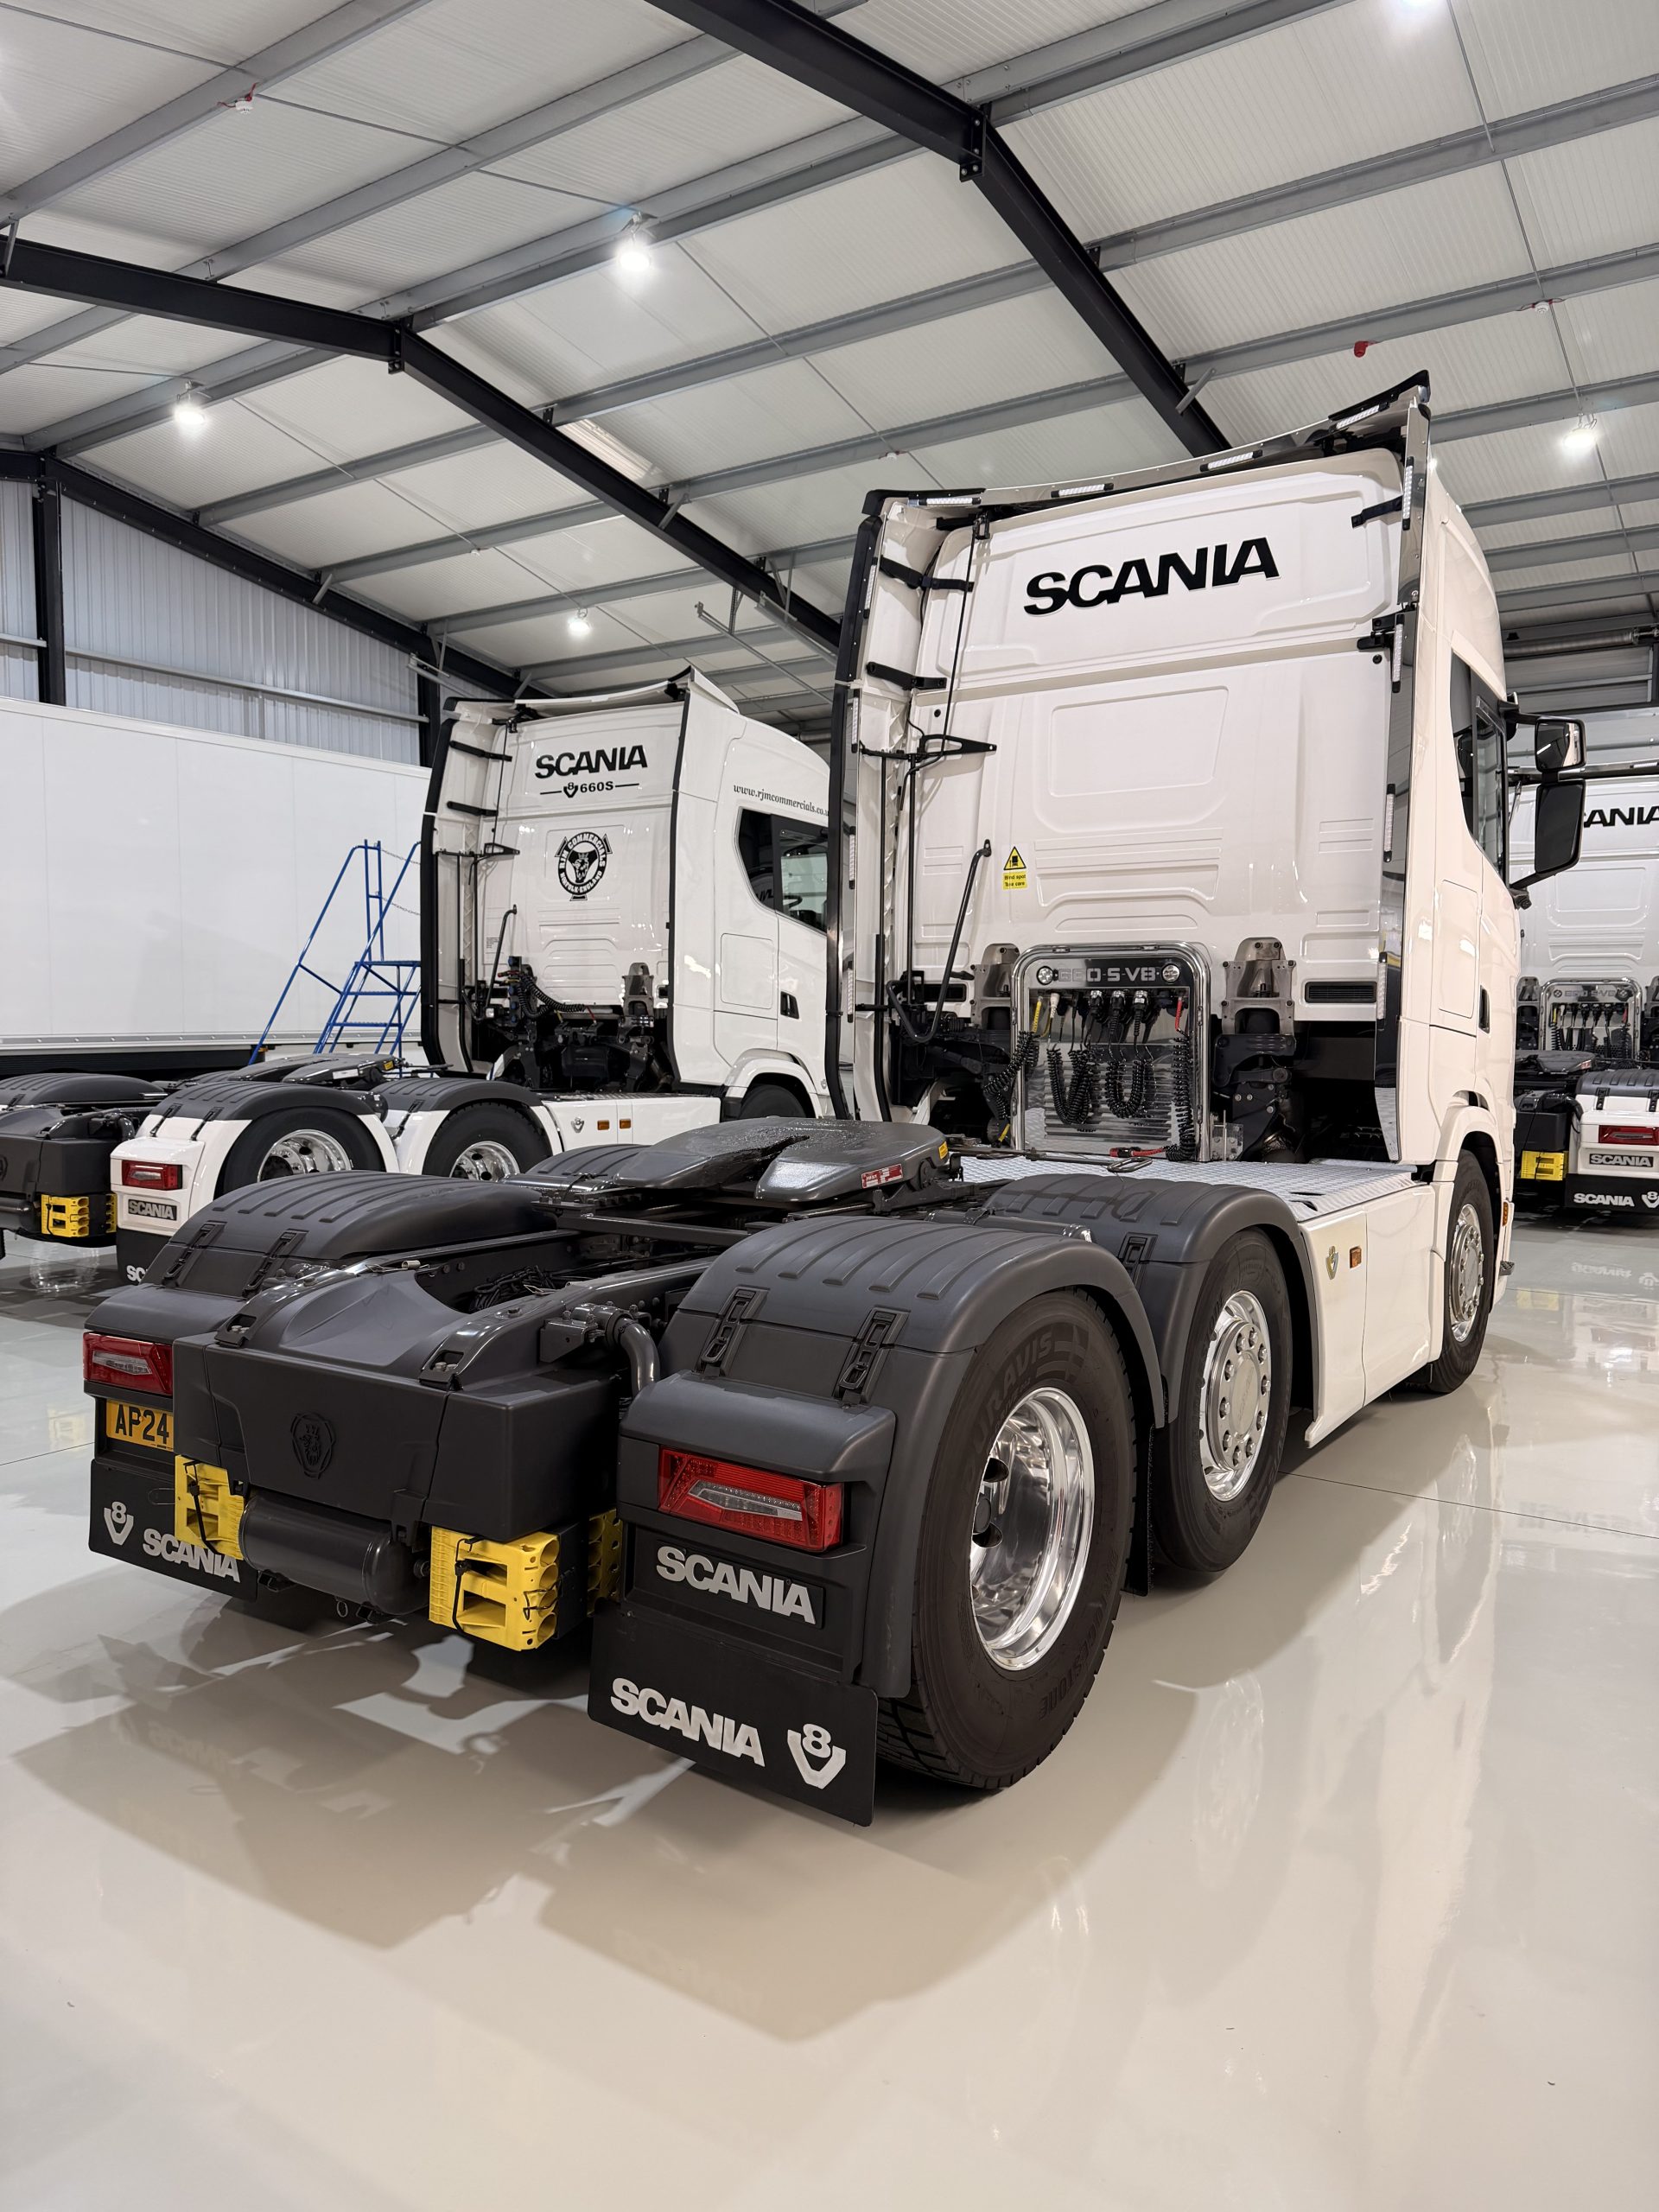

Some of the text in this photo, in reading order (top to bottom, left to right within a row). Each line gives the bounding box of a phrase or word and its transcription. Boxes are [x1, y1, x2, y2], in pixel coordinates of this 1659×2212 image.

[1023, 537, 1280, 615] SCANIA
[535, 745, 648, 779] SCANIA
[580, 781, 614, 793] 660S
[567, 833, 607, 868] COMMERCIALS
[579, 870, 602, 893] ENGLAND
[1591, 1154, 1651, 1166] SCANIA
[129, 1200, 175, 1219] SCANIA
[1573, 1192, 1635, 1207] SCANIA
[115, 1403, 169, 1445] AP24
[142, 1528, 241, 1583] SCANIA
[656, 1546, 817, 1624] SCANIA
[610, 1677, 766, 1768] SCANIA
